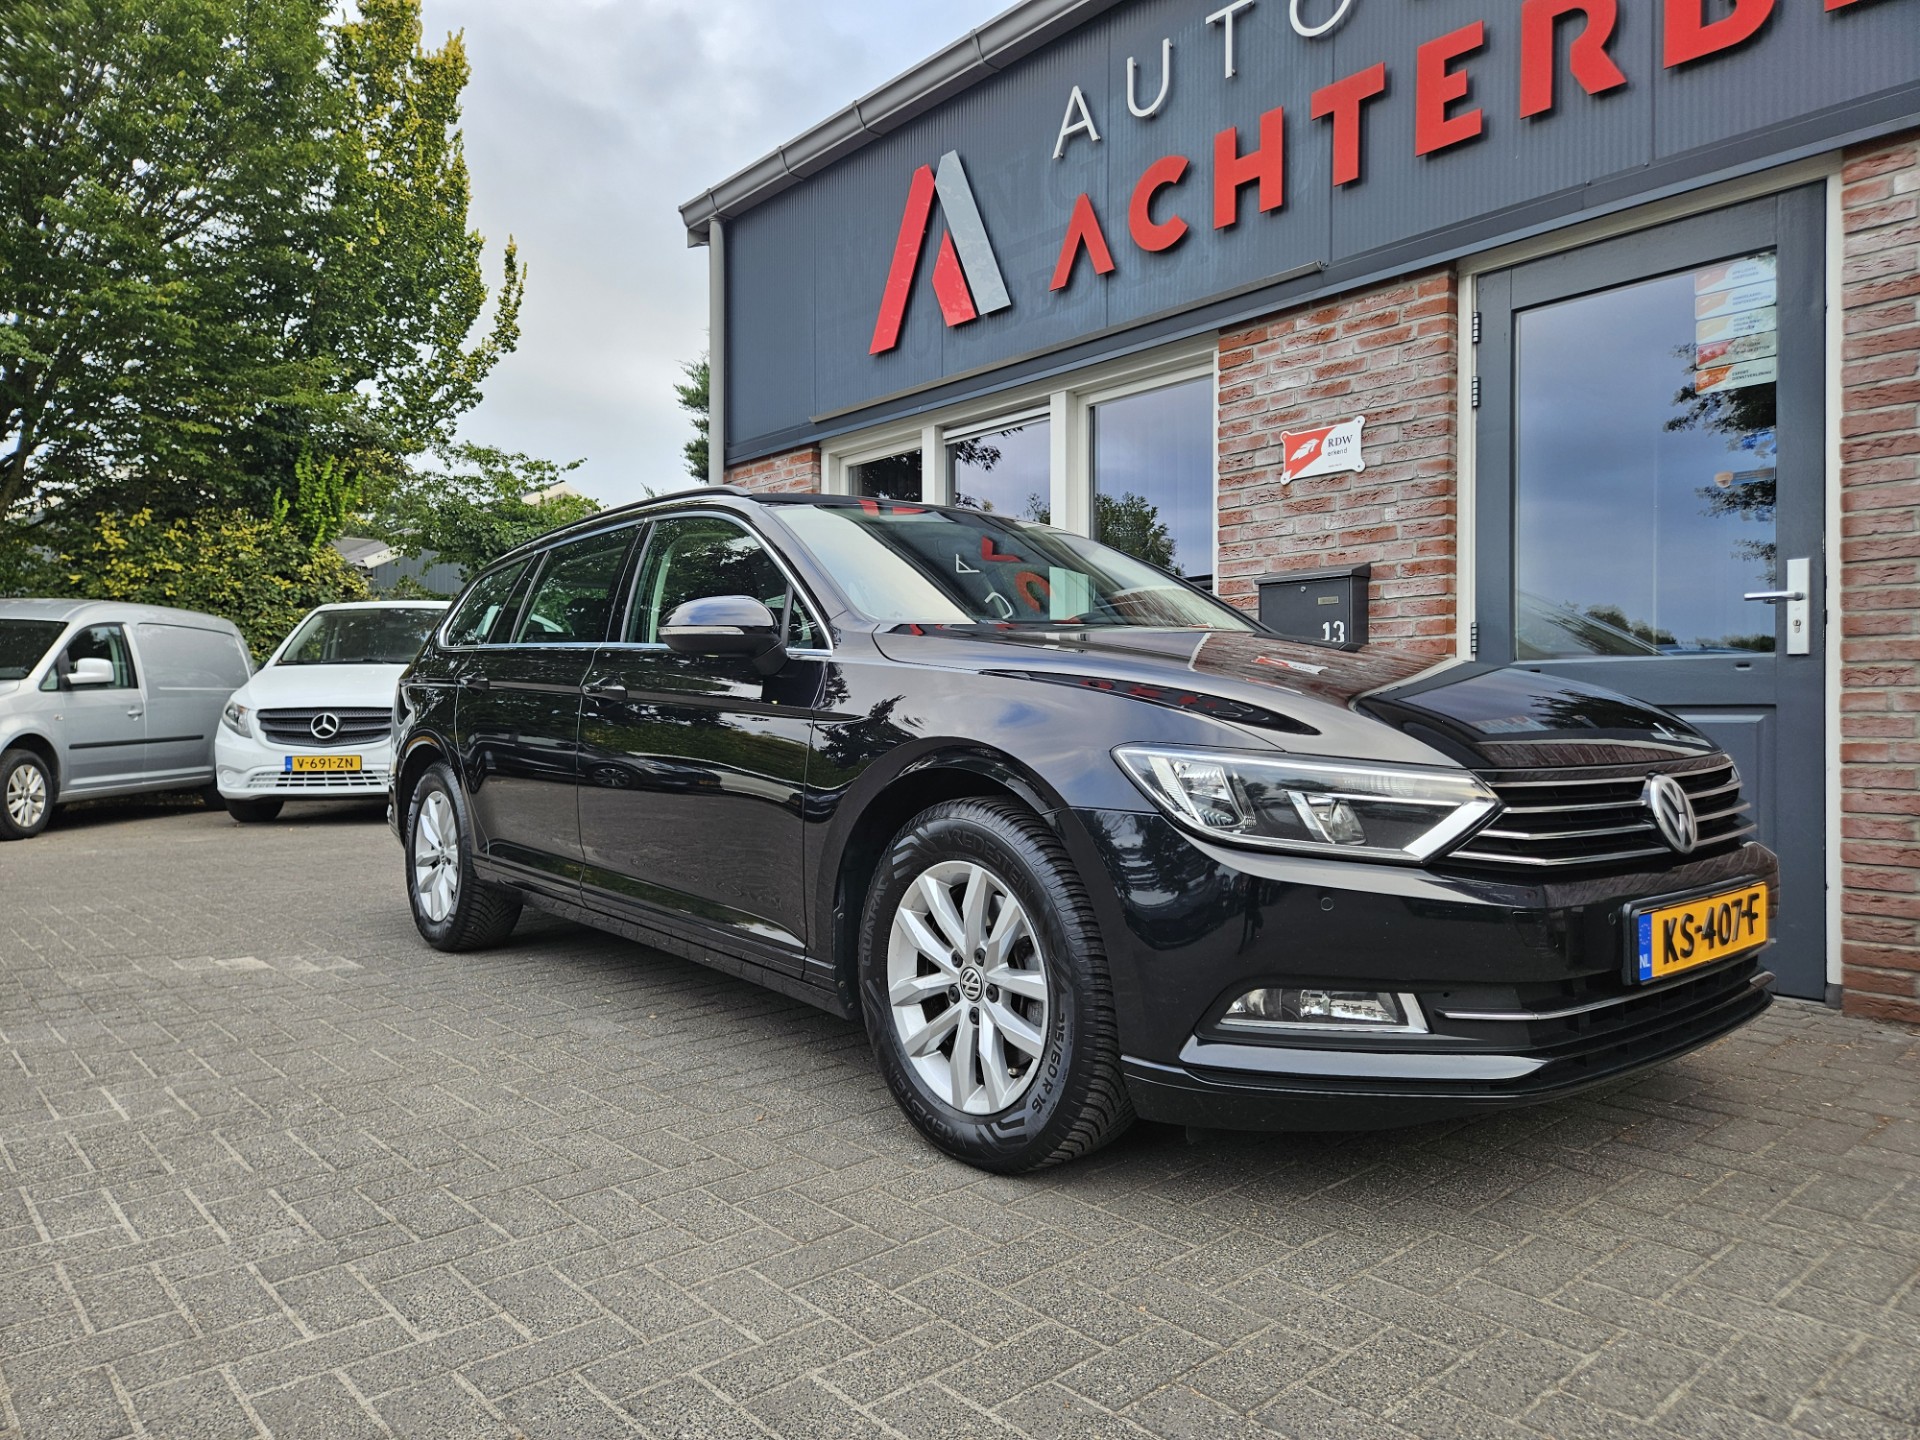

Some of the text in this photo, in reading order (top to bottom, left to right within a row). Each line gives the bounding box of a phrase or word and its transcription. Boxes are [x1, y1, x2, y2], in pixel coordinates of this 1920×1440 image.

[1048, 0, 1859, 292] ACHTER
[1327, 434, 1354, 448] RDW
[1321, 620, 1345, 643] 13
[296, 757, 354, 769] V-691-ZN
[1662, 892, 1760, 966] KS-407-F
[1639, 953, 1651, 970] NL
